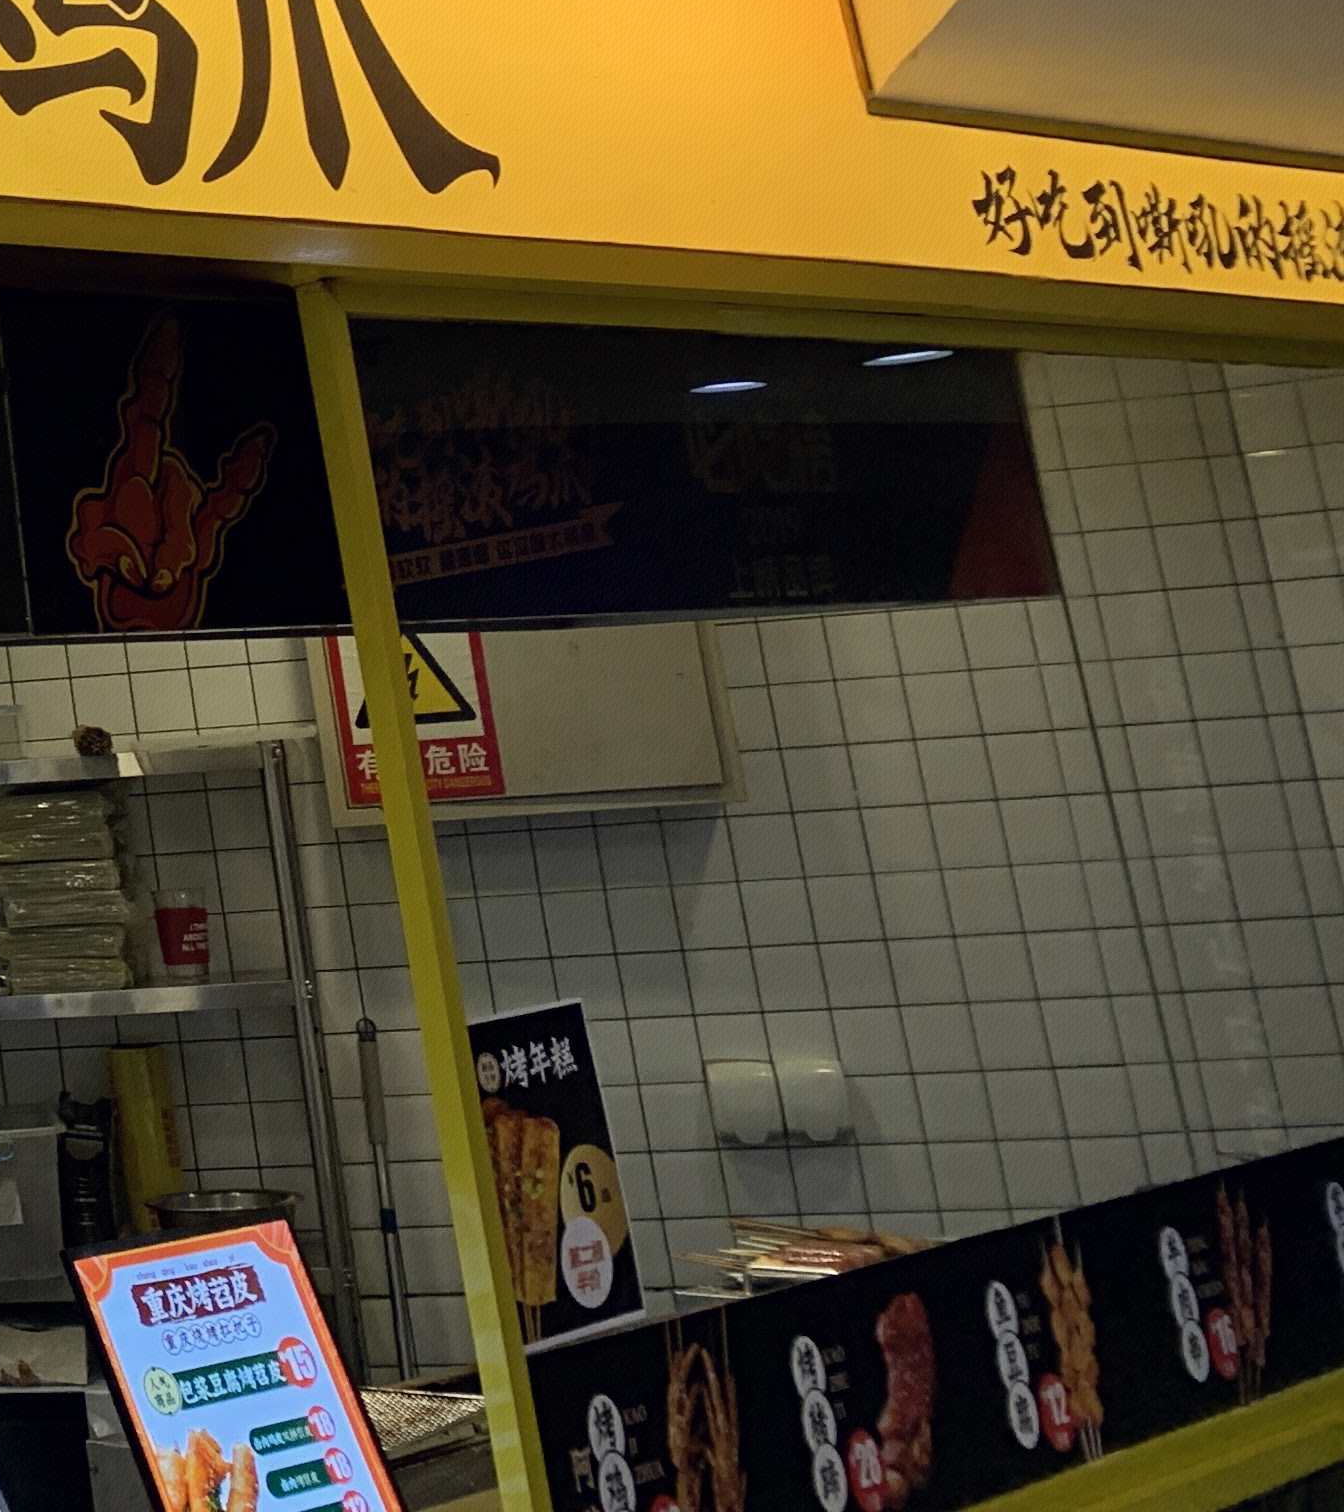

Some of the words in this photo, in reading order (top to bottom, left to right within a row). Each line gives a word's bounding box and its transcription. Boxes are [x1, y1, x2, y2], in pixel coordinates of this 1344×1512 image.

[356, 743, 490, 780] 有危险
[501, 1037, 579, 1088] 烤年糕
[141, 1270, 258, 1323] 重庆烤苕皮
[179, 1359, 288, 1405] 包浆豆腐烤苕皮
